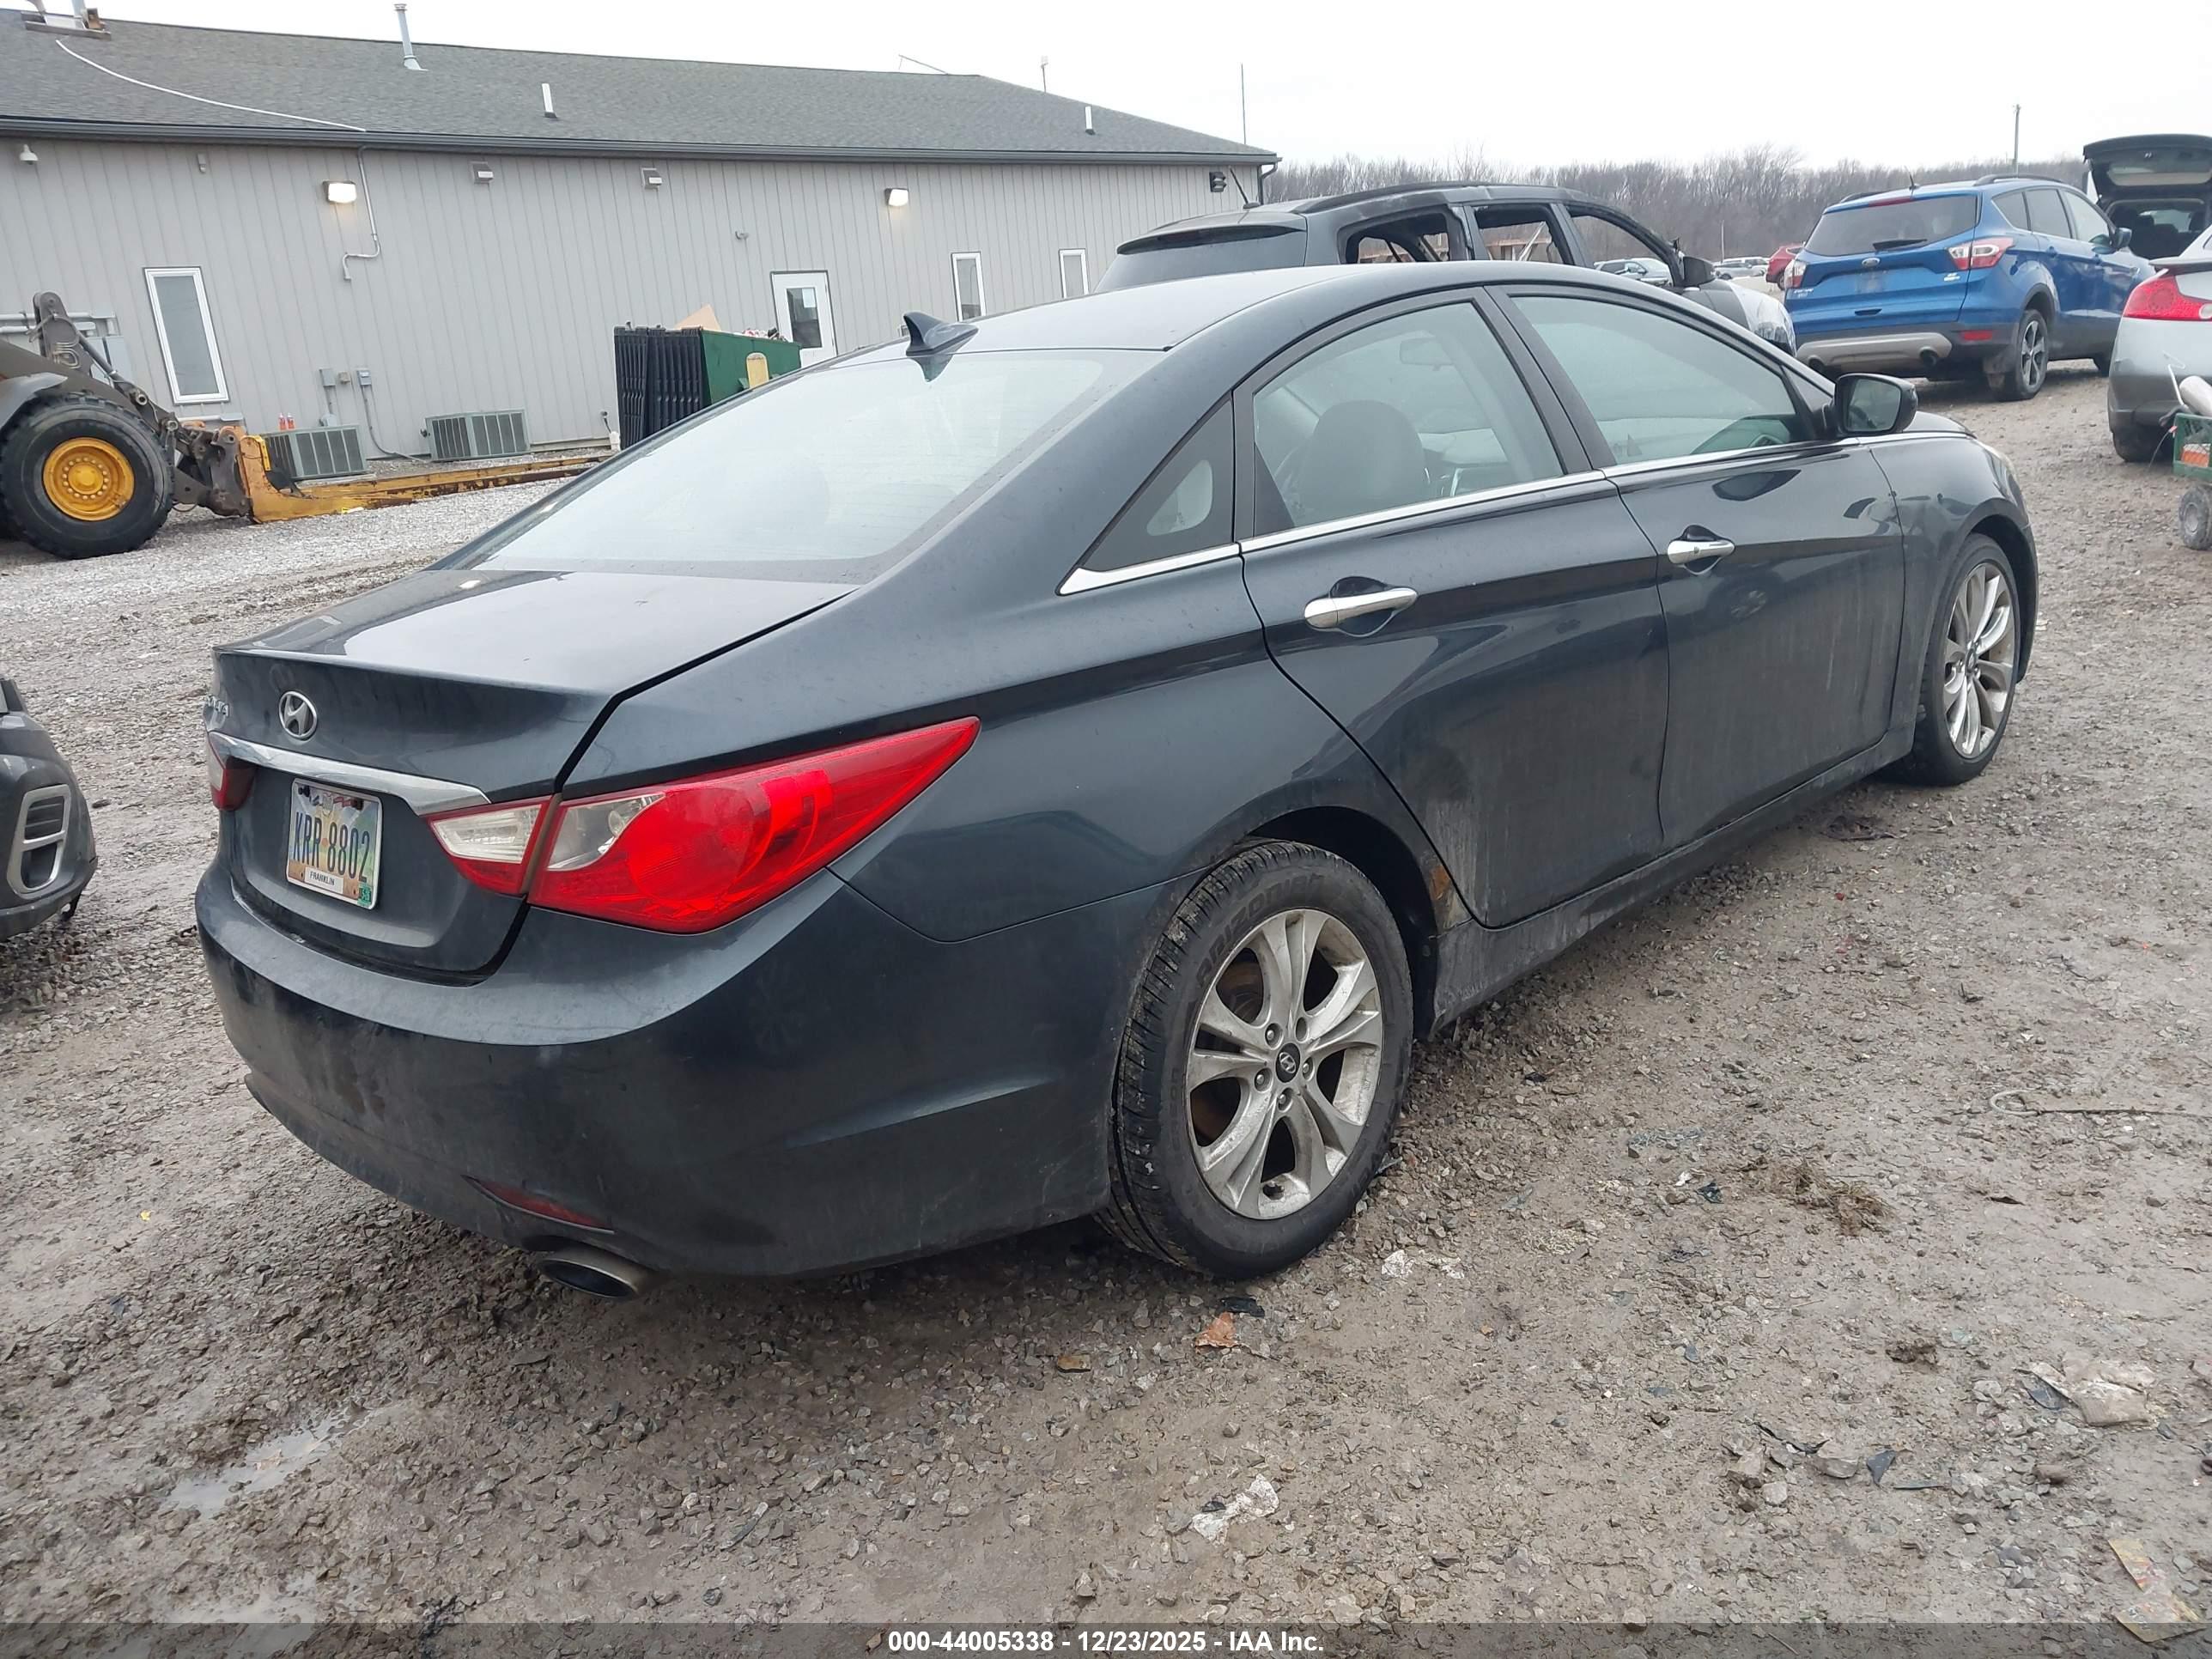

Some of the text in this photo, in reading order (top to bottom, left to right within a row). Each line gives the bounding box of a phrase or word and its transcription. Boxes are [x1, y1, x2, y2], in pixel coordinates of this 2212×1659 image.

[293, 811, 370, 884] KRR 8802
[309, 871, 336, 886] FRANKLIN
